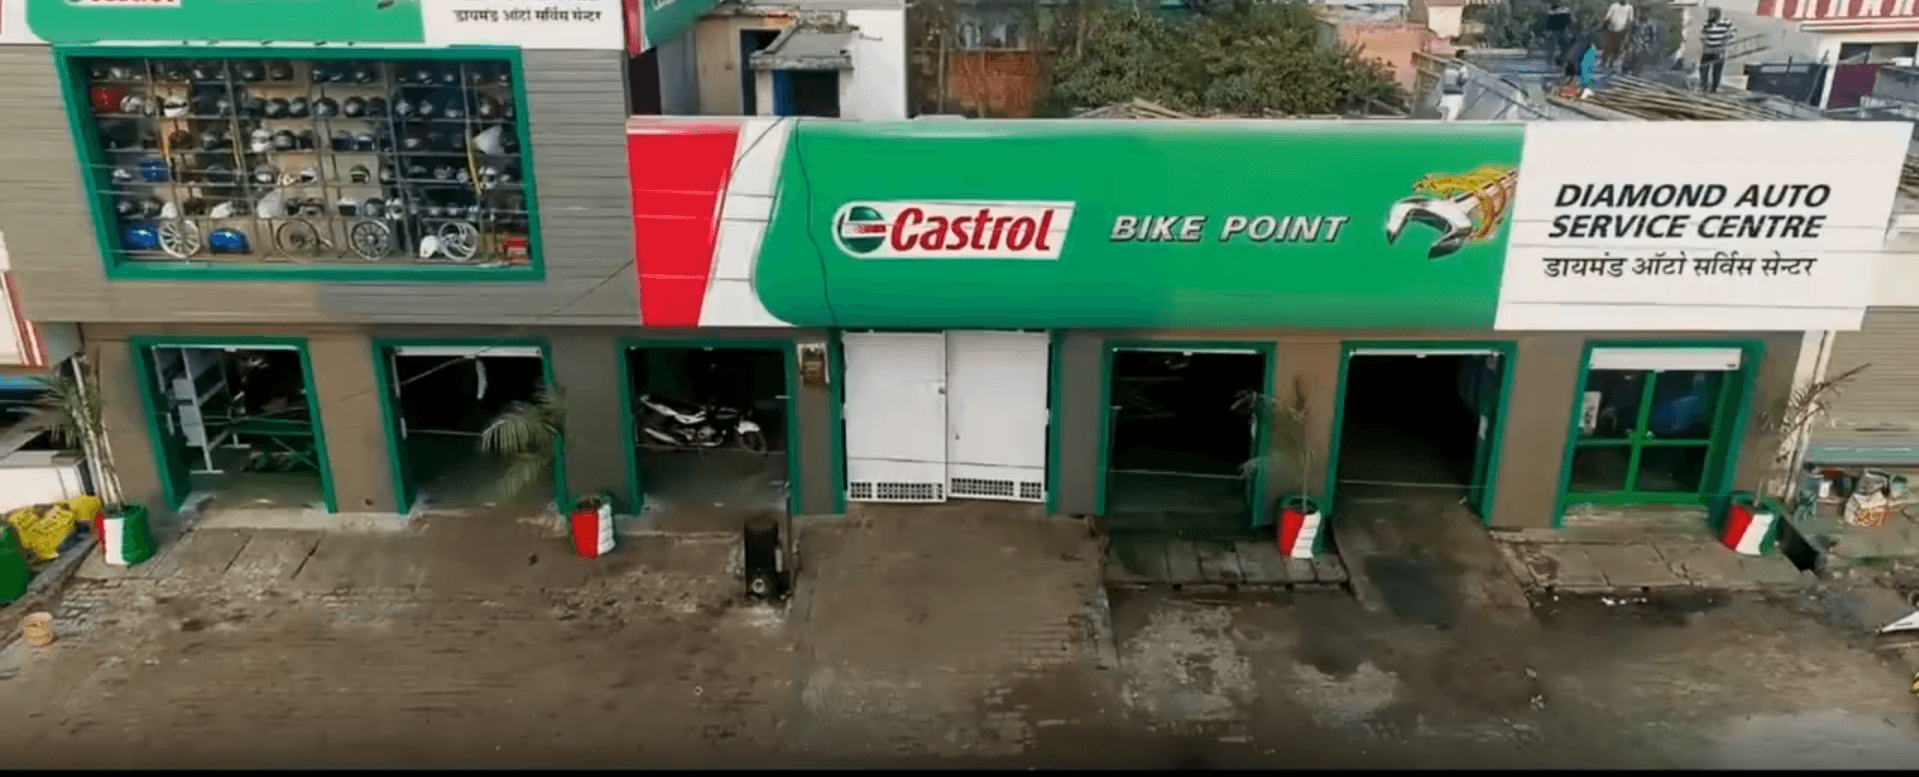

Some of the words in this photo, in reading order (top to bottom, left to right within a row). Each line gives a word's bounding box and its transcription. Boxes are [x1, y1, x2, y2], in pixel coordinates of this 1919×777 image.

[1554, 183, 1728, 209] DIAMOND
[1733, 183, 1831, 209] AUTO
[890, 207, 1055, 252] Castrol
[1110, 215, 1208, 243] BIKE
[1218, 215, 1350, 243] POINT
[1548, 214, 1690, 239] SERVICE
[1696, 214, 1827, 239] CENTRE
[1542, 251, 1627, 278] डायमंड
[1631, 251, 1689, 276] ऑटो
[1693, 250, 1756, 276] सर्विस
[1760, 251, 1818, 277] सेन्टर
